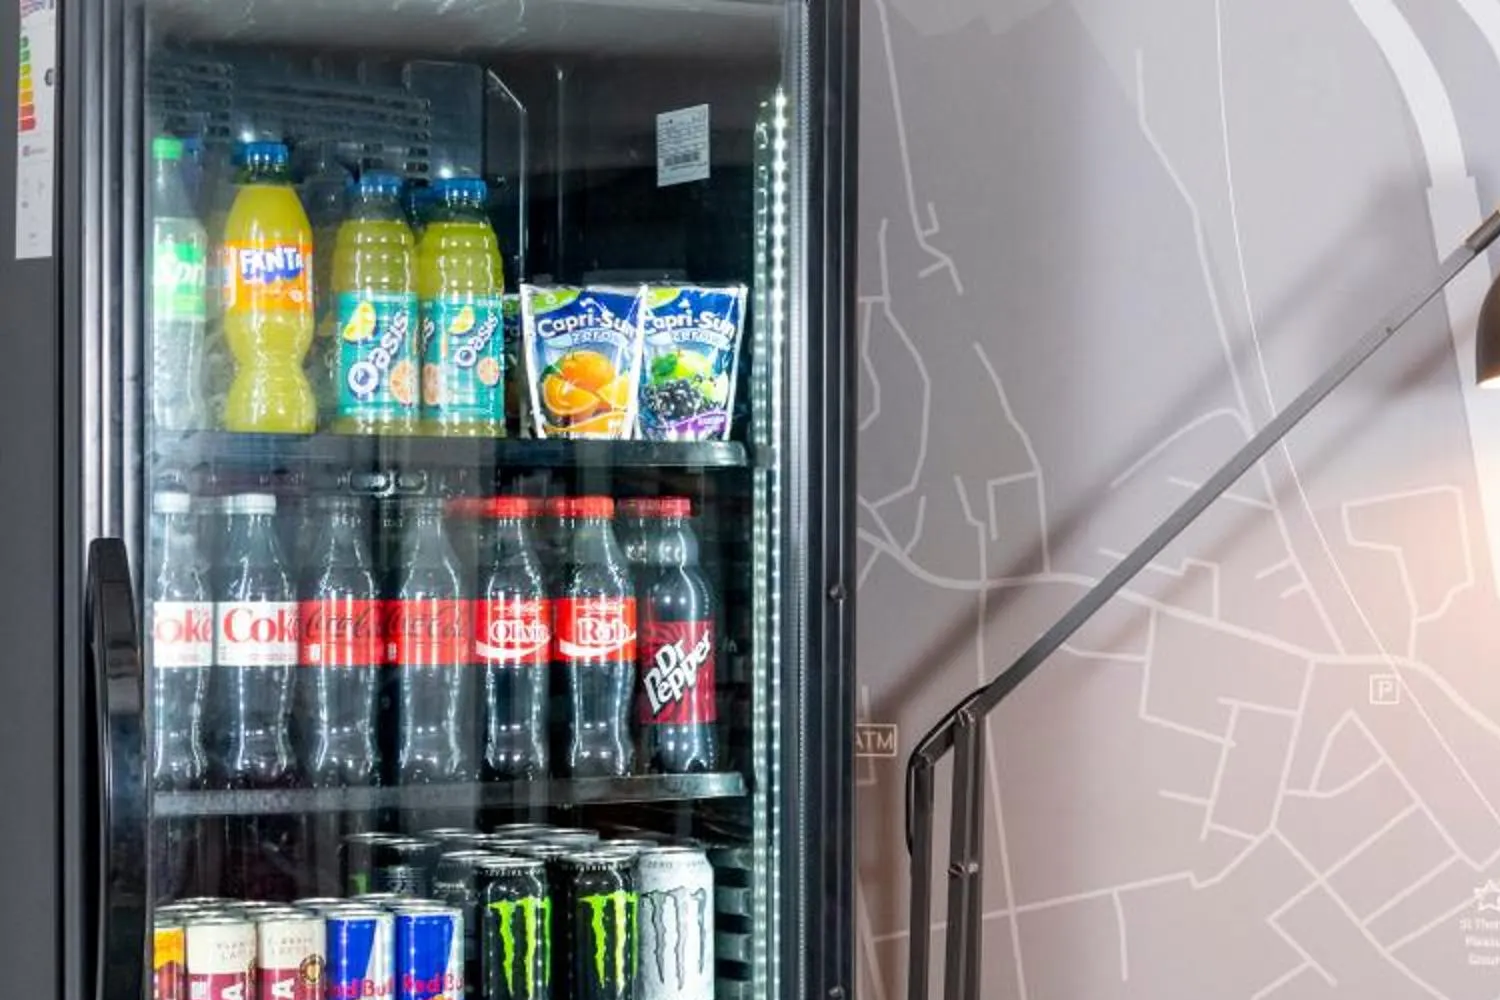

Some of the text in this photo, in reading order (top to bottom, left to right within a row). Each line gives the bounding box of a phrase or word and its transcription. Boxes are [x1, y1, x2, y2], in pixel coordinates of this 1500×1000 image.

[348, 309, 409, 397] Oasis
[454, 311, 499, 368] Oasis
[578, 617, 631, 643] Rob
[643, 630, 711, 714] Pepper
[655, 638, 686, 678] Dr
[403, 972, 465, 993] Red Bu
